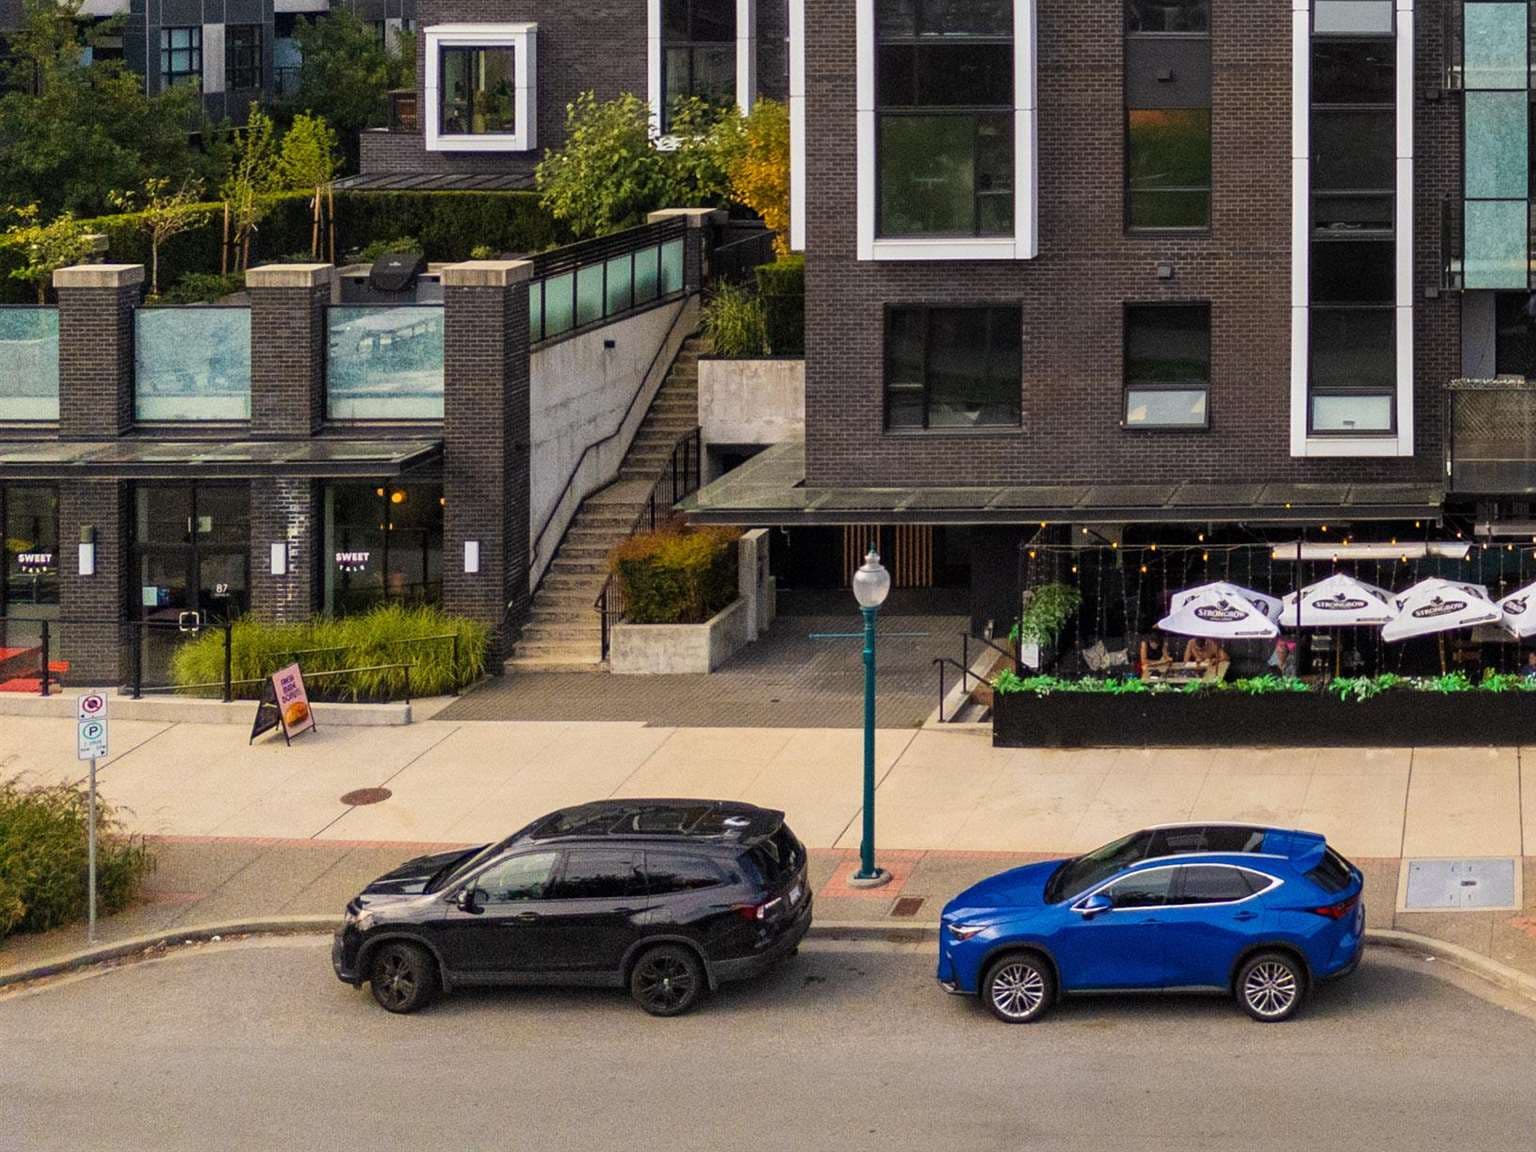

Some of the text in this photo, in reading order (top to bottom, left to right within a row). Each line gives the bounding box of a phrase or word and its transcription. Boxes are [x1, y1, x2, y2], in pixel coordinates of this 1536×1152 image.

[18, 553, 52, 563] SWEET
[335, 552, 370, 562] SWEET
[216, 584, 229, 593] 87
[89, 726, 98, 736] P
